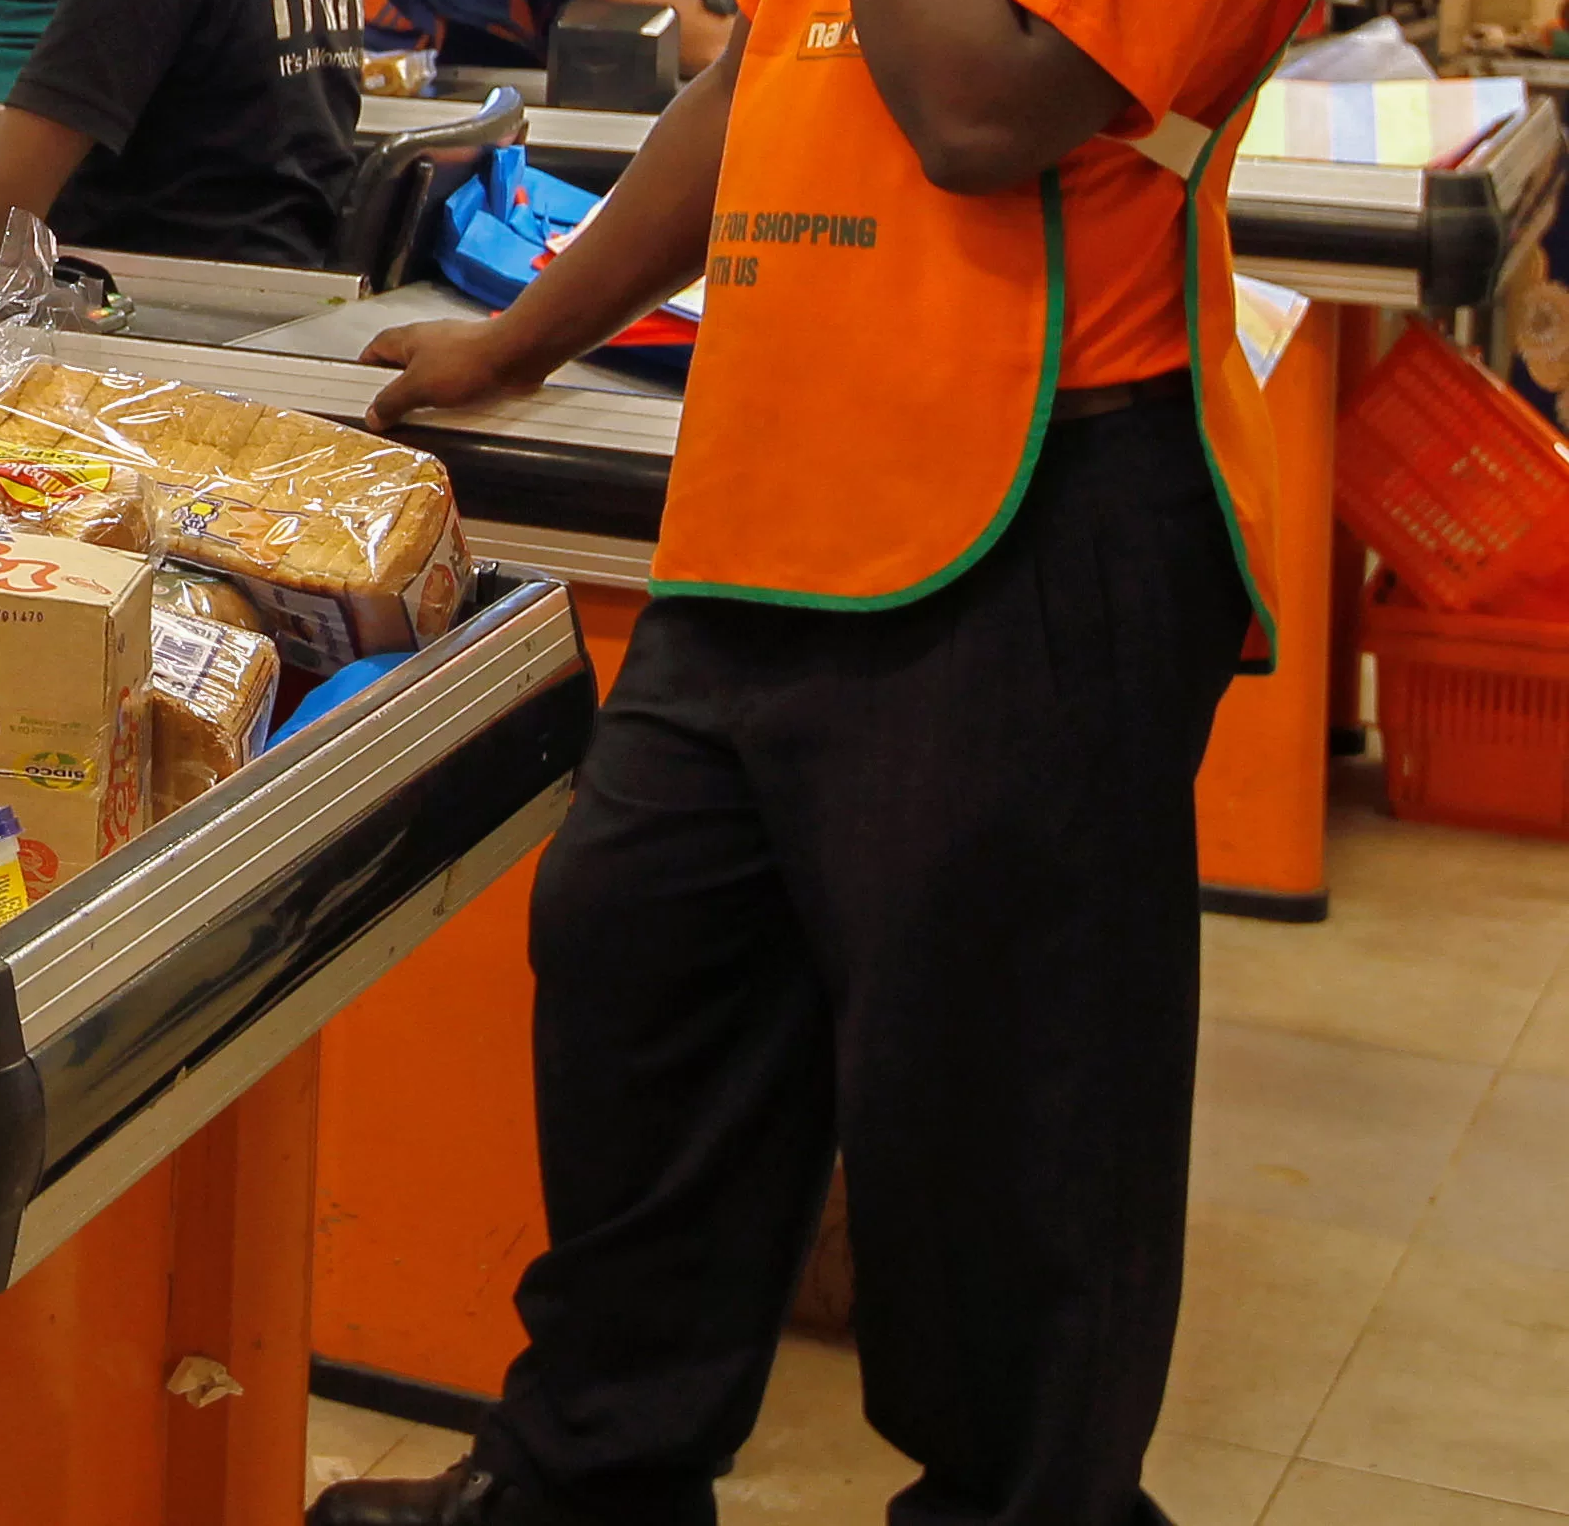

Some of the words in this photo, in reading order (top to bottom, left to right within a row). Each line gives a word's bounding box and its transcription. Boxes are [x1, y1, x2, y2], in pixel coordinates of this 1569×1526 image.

[752, 210, 878, 248] SHOPPING
[734, 256, 759, 287] US
[25, 766, 86, 780] BIDCO
